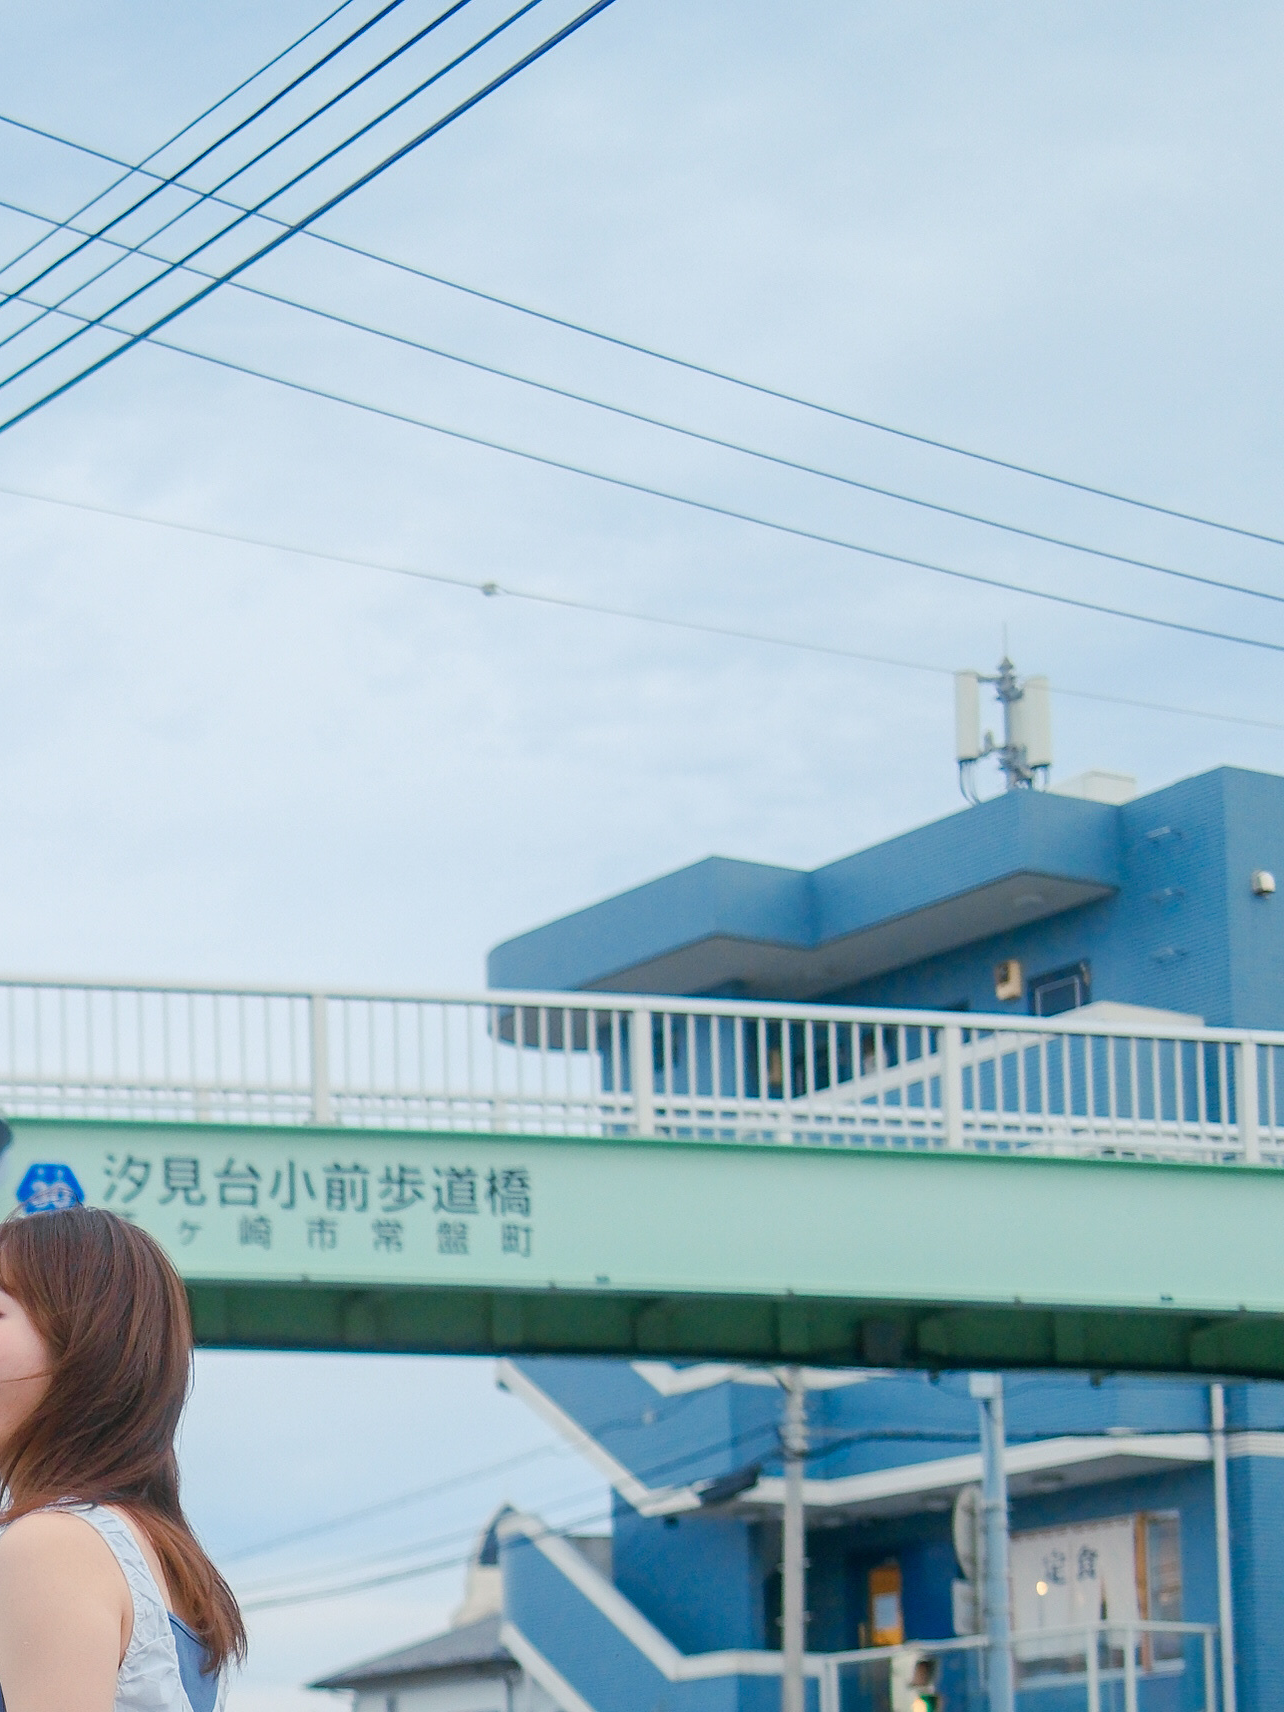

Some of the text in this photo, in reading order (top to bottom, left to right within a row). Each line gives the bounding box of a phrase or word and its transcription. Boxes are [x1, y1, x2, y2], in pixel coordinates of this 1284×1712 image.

[104, 1154, 531, 1217] 汐見台小前歩道橋
[118, 1210, 533, 1258] ヶ崎市常盤町
